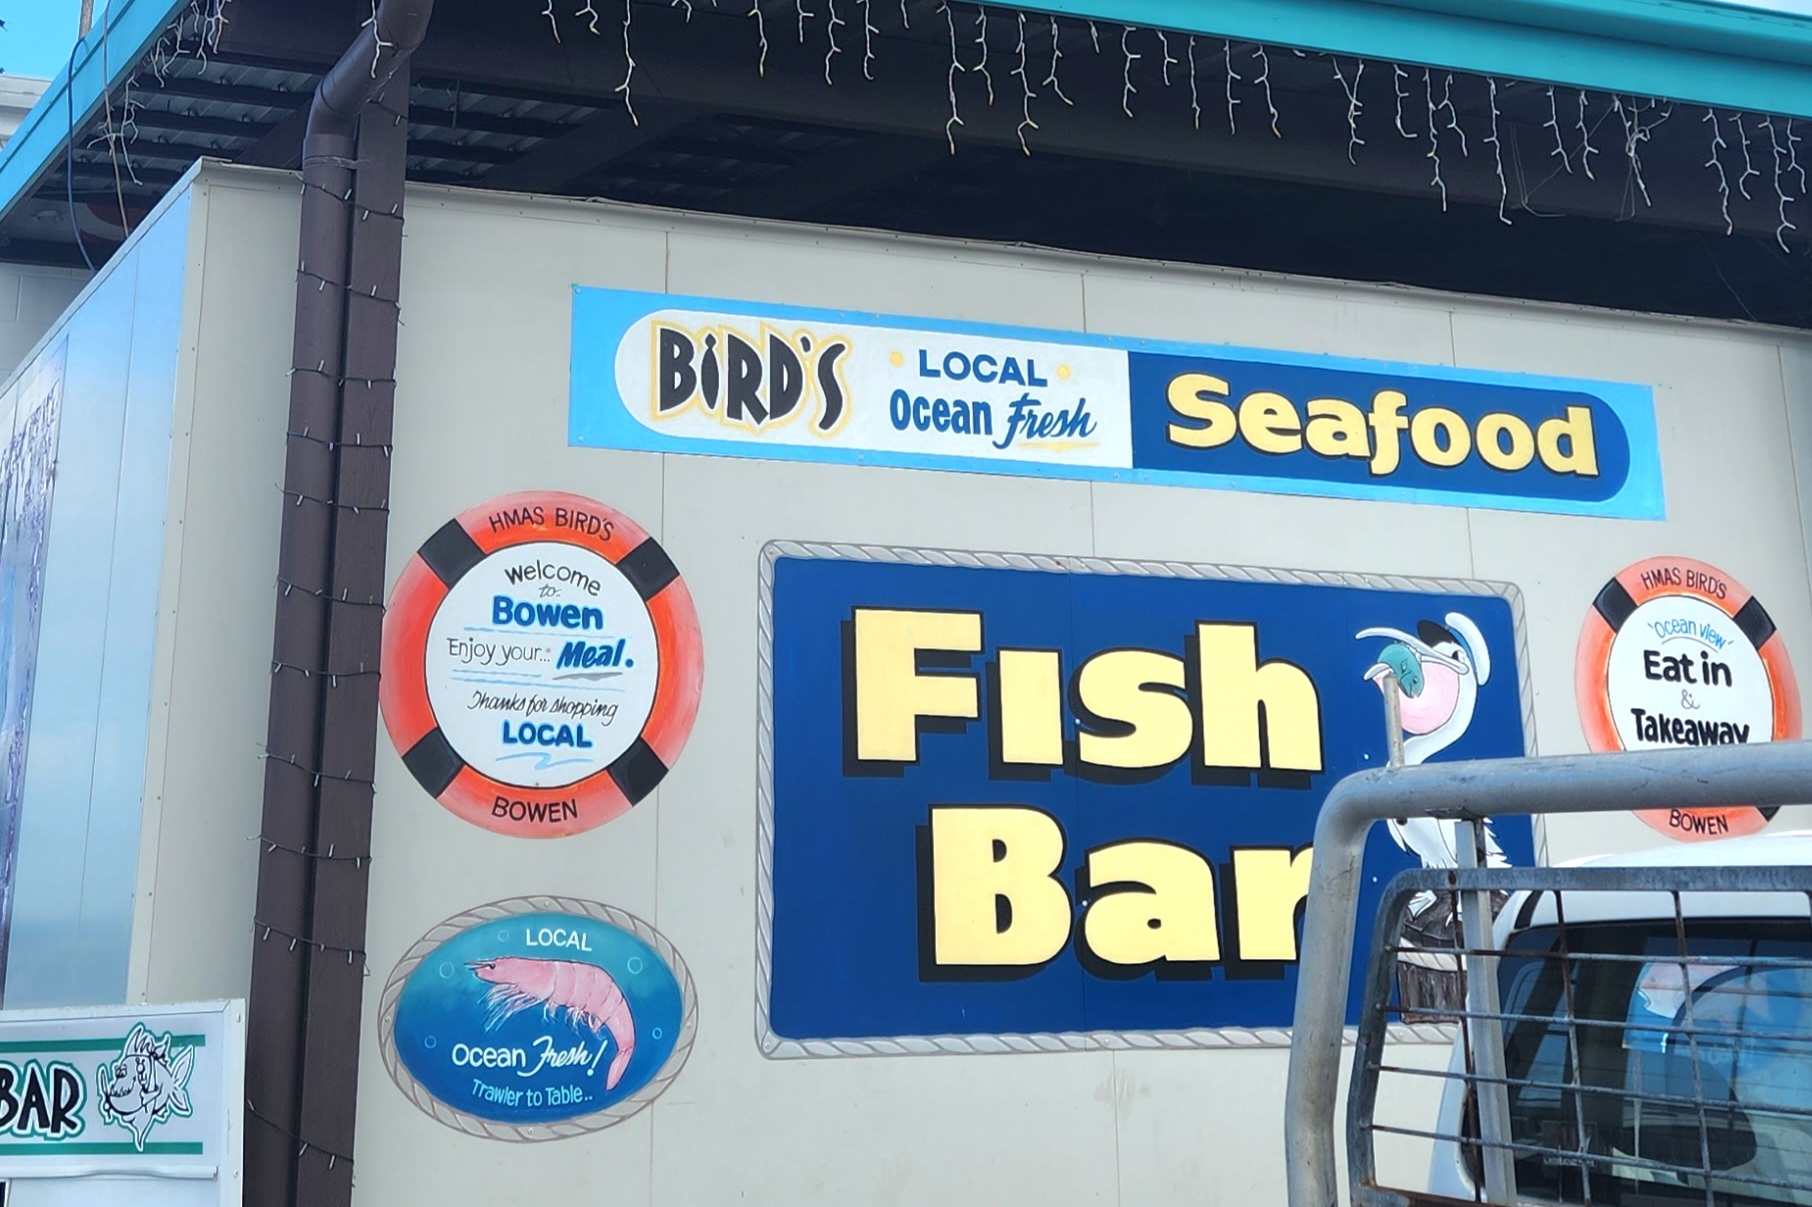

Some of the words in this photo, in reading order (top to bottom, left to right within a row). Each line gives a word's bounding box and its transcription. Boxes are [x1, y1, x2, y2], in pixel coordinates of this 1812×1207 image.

[918, 348, 1049, 388] LOCAL
[889, 388, 994, 437] Ocean
[992, 392, 1098, 450] Fresh
[1165, 372, 1600, 476] Seafood
[488, 506, 545, 534] HMAS
[555, 507, 615, 542] BIRD'S
[1641, 567, 1682, 591] HMAS
[1686, 569, 1728, 601] BIRD'S
[492, 595, 604, 630] Bowen
[446, 637, 496, 666] Enjoy
[1643, 649, 1697, 684] Eat
[1701, 650, 1733, 687] in
[850, 606, 1325, 774] Fish
[1680, 689, 1701, 710] &
[467, 690, 527, 711] Thanks
[525, 693, 549, 717] for
[550, 695, 619, 727] shopping
[502, 721, 593, 748] LOCAL
[1630, 707, 1750, 747] Takeaway
[491, 796, 579, 824] BOWEN
[1668, 808, 1729, 836] BOWEN
[929, 804, 1312, 967] Bar
[525, 928, 593, 952] LOCAL
[452, 1043, 527, 1068] Ocean
[516, 1035, 609, 1078] Fresh!
[472, 1078, 524, 1108] Trawler
[526, 1089, 543, 1108] to
